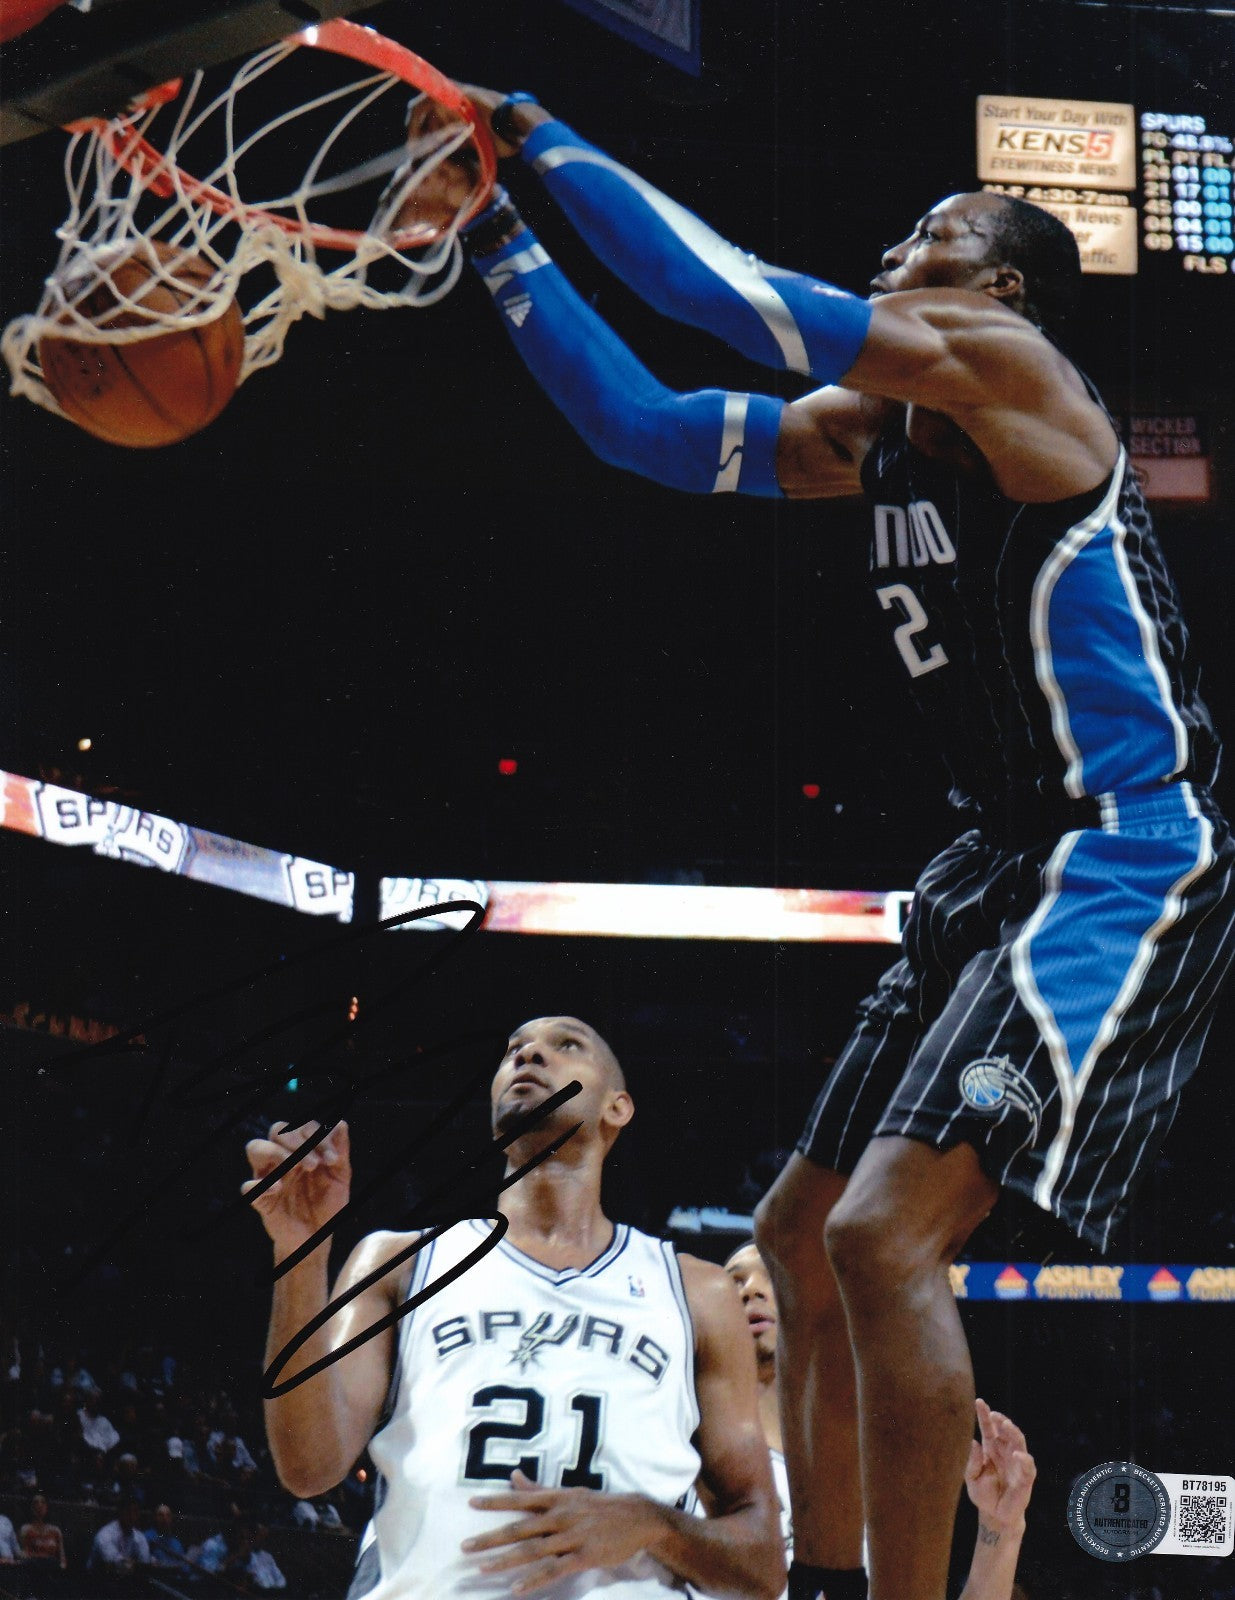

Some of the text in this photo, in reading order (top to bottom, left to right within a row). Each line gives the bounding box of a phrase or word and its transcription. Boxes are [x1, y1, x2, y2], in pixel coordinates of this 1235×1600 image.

[984, 104, 1128, 127] Start Your Day With
[1141, 113, 1206, 133] SPURS
[991, 158, 1118, 176] EYEWITNESS NEWS
[1174, 183, 1201, 199] 17
[1076, 208, 1122, 225] News
[1176, 235, 1203, 252] 15
[56, 797, 174, 856] SPURS
[1034, 1265, 1124, 1286] ASHLEY
[432, 1310, 671, 1381] SPURS
[462, 1383, 605, 1491] 21
[1183, 1480, 1227, 1492] BT78195
[1075, 1467, 1113, 1555] BECKETT VERIFIED AUTHENTIC
[1130, 1468, 1167, 1557] BECKETT VERIFIED AUTHENTIC
[1094, 1518, 1149, 1529] AUTHENTICATED
